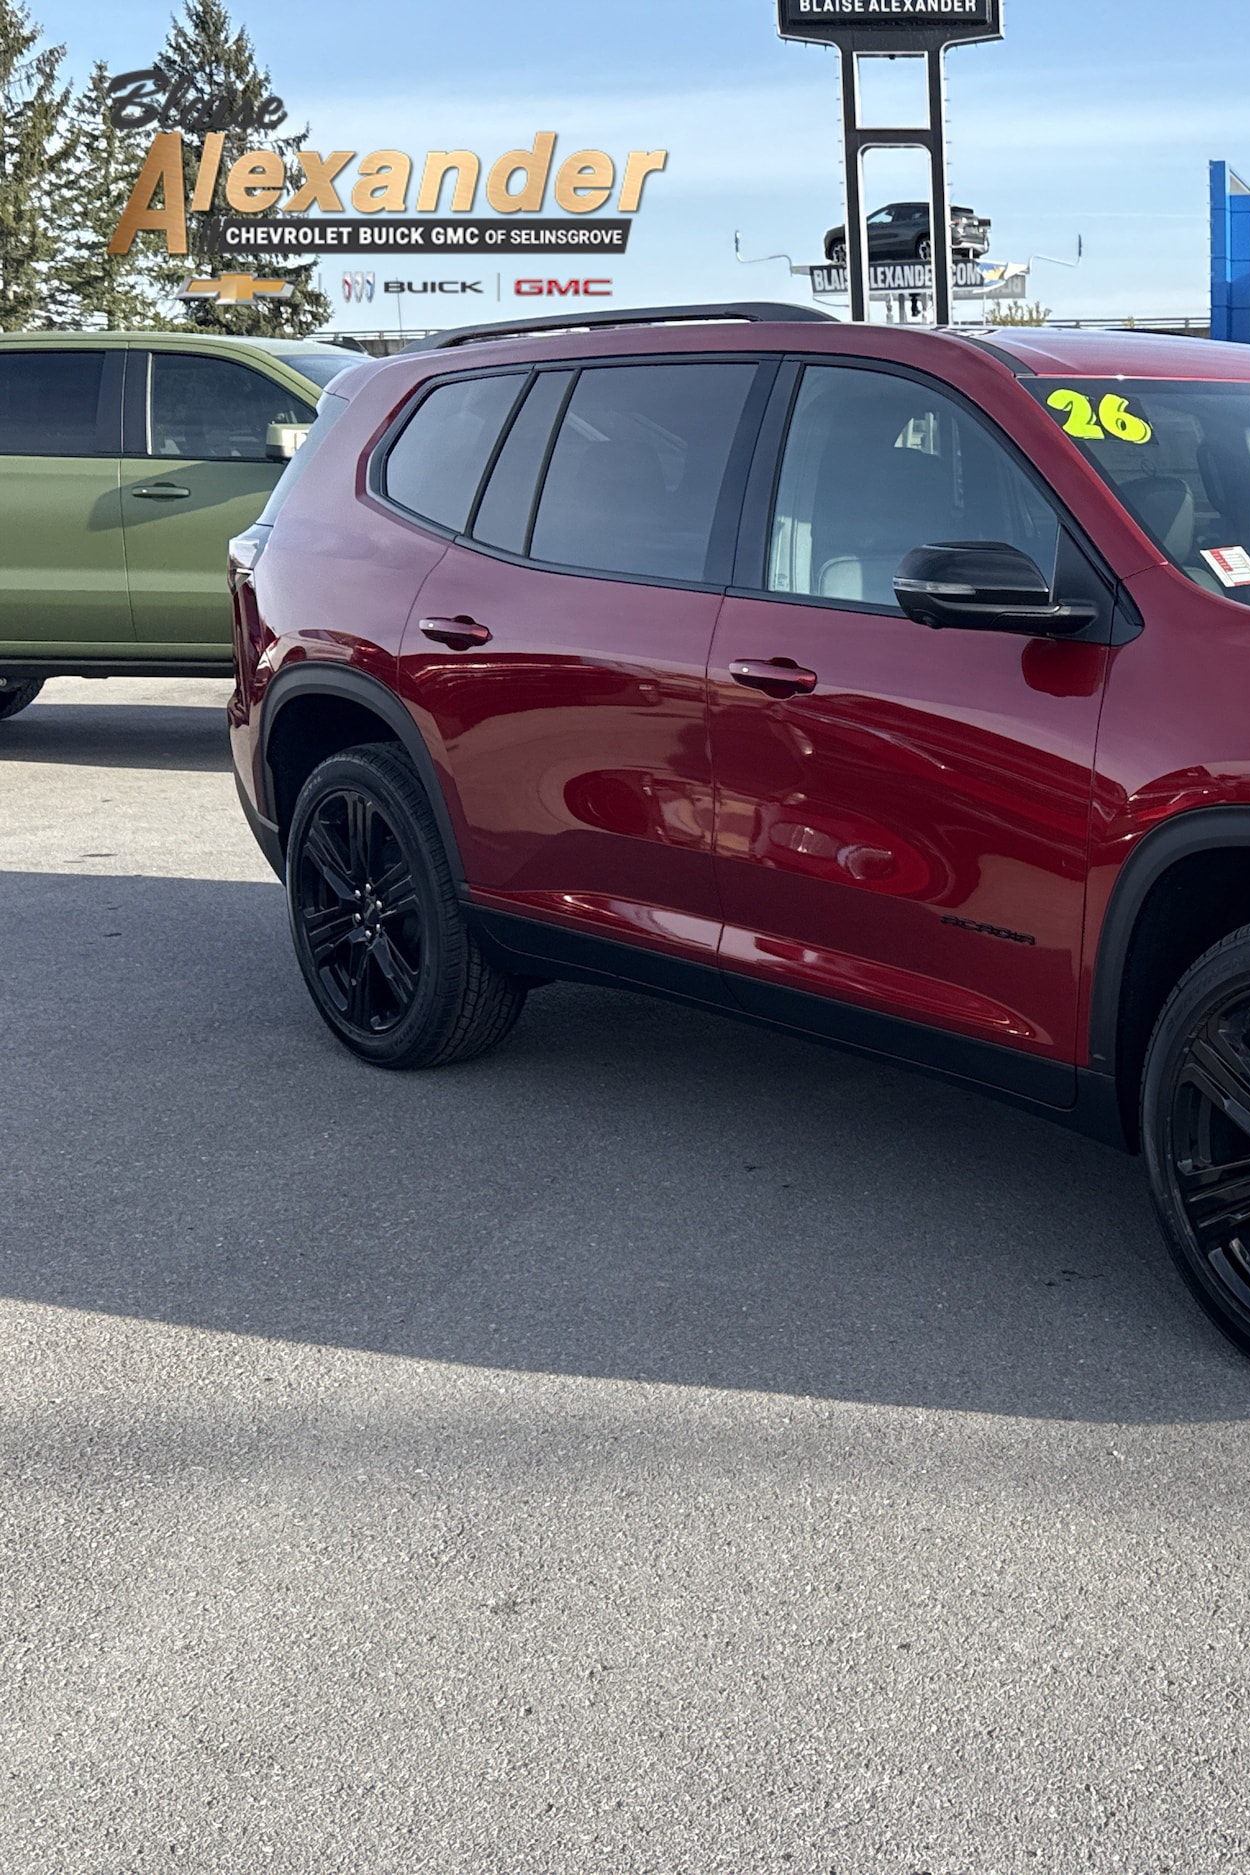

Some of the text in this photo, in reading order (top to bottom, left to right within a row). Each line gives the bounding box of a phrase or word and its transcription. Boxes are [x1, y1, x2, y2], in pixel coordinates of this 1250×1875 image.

[799, 0, 977, 12] BLAISE ALEXANDER
[1046, 388, 1152, 444] 26
[939, 914, 1036, 946] ACADIA
